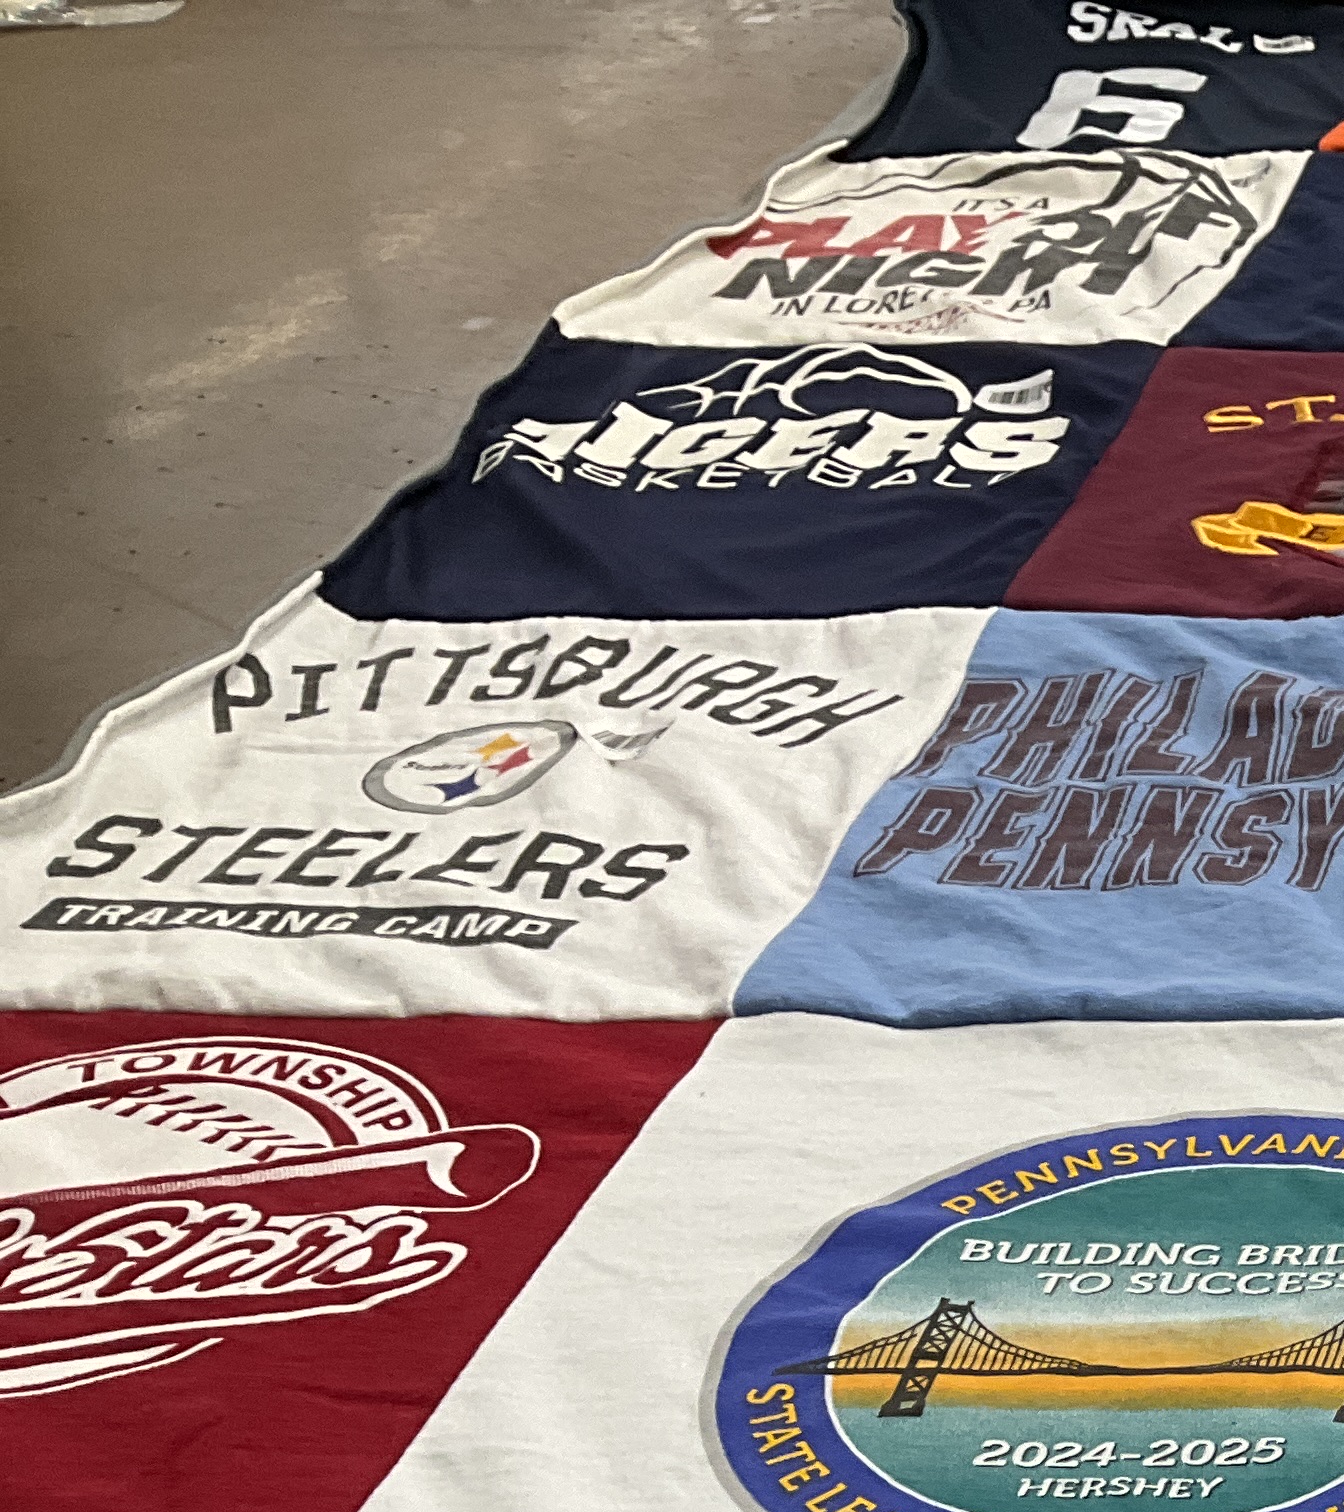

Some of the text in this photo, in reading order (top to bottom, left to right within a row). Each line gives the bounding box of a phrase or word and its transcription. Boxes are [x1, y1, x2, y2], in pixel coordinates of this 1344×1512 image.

[1067, 1, 1243, 52] SRAL
[1015, 67, 1208, 149] 6
[211, 633, 903, 749] PITTSBURGH
[46, 814, 691, 902] STEELERS
[55, 902, 558, 945] TRAINING CAMP
[66, 1051, 412, 1134] TOWNSHIP
[959, 1238, 1222, 1267] BUILDING
[1034, 1270, 1116, 1296] TO
[744, 1382, 810, 1495] STATE
[972, 1435, 1287, 1469] 2024-2025
[1016, 1475, 1224, 1501] HERSHEY
